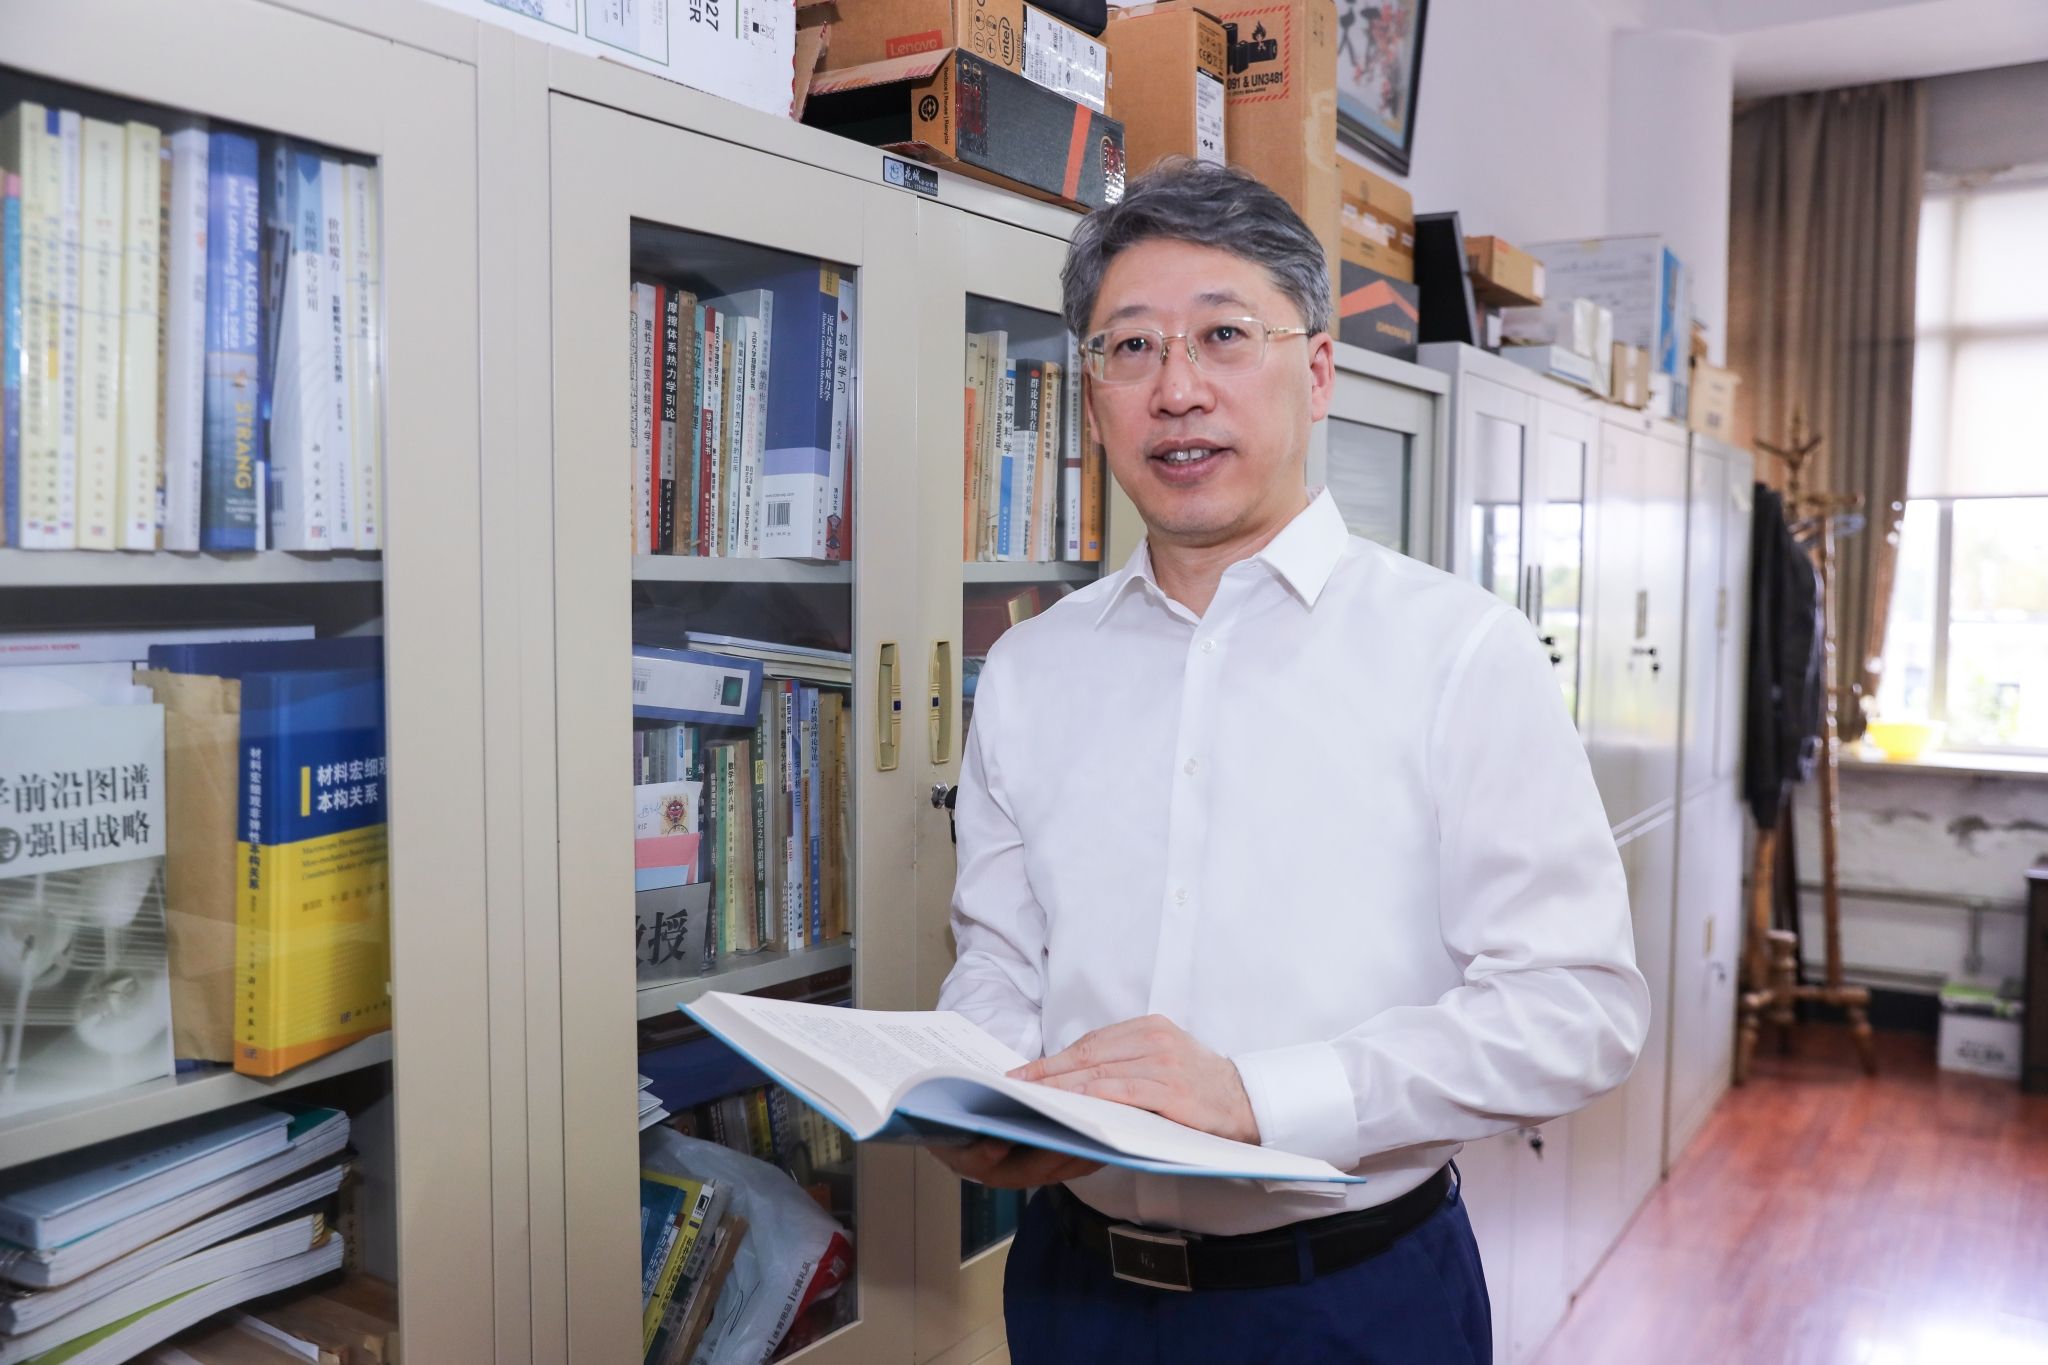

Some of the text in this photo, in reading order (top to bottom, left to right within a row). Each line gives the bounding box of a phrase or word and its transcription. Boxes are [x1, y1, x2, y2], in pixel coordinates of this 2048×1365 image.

[890, 38, 938, 57] Lenovo
[1001, 25, 1010, 60] intel
[1243, 74, 1250, 88] &
[1251, 71, 1284, 87] UN3481
[223, 174, 242, 350] and Learning from Data
[243, 186, 259, 347] LINEAR ALGEBRA
[664, 301, 678, 420] 摩擦体系热力学引论
[824, 313, 835, 401] 近代连续介质力学
[838, 331, 849, 394] 机器学习
[234, 402, 252, 490] STRANG
[1003, 379, 1015, 454] 计算材料学
[810, 699, 819, 762] 工程波动理论导论
[249, 748, 261, 890] 材料宏细观非弹性本构关系
[317, 782, 379, 814] 本构关系
[25, 809, 150, 858] 强国战略
